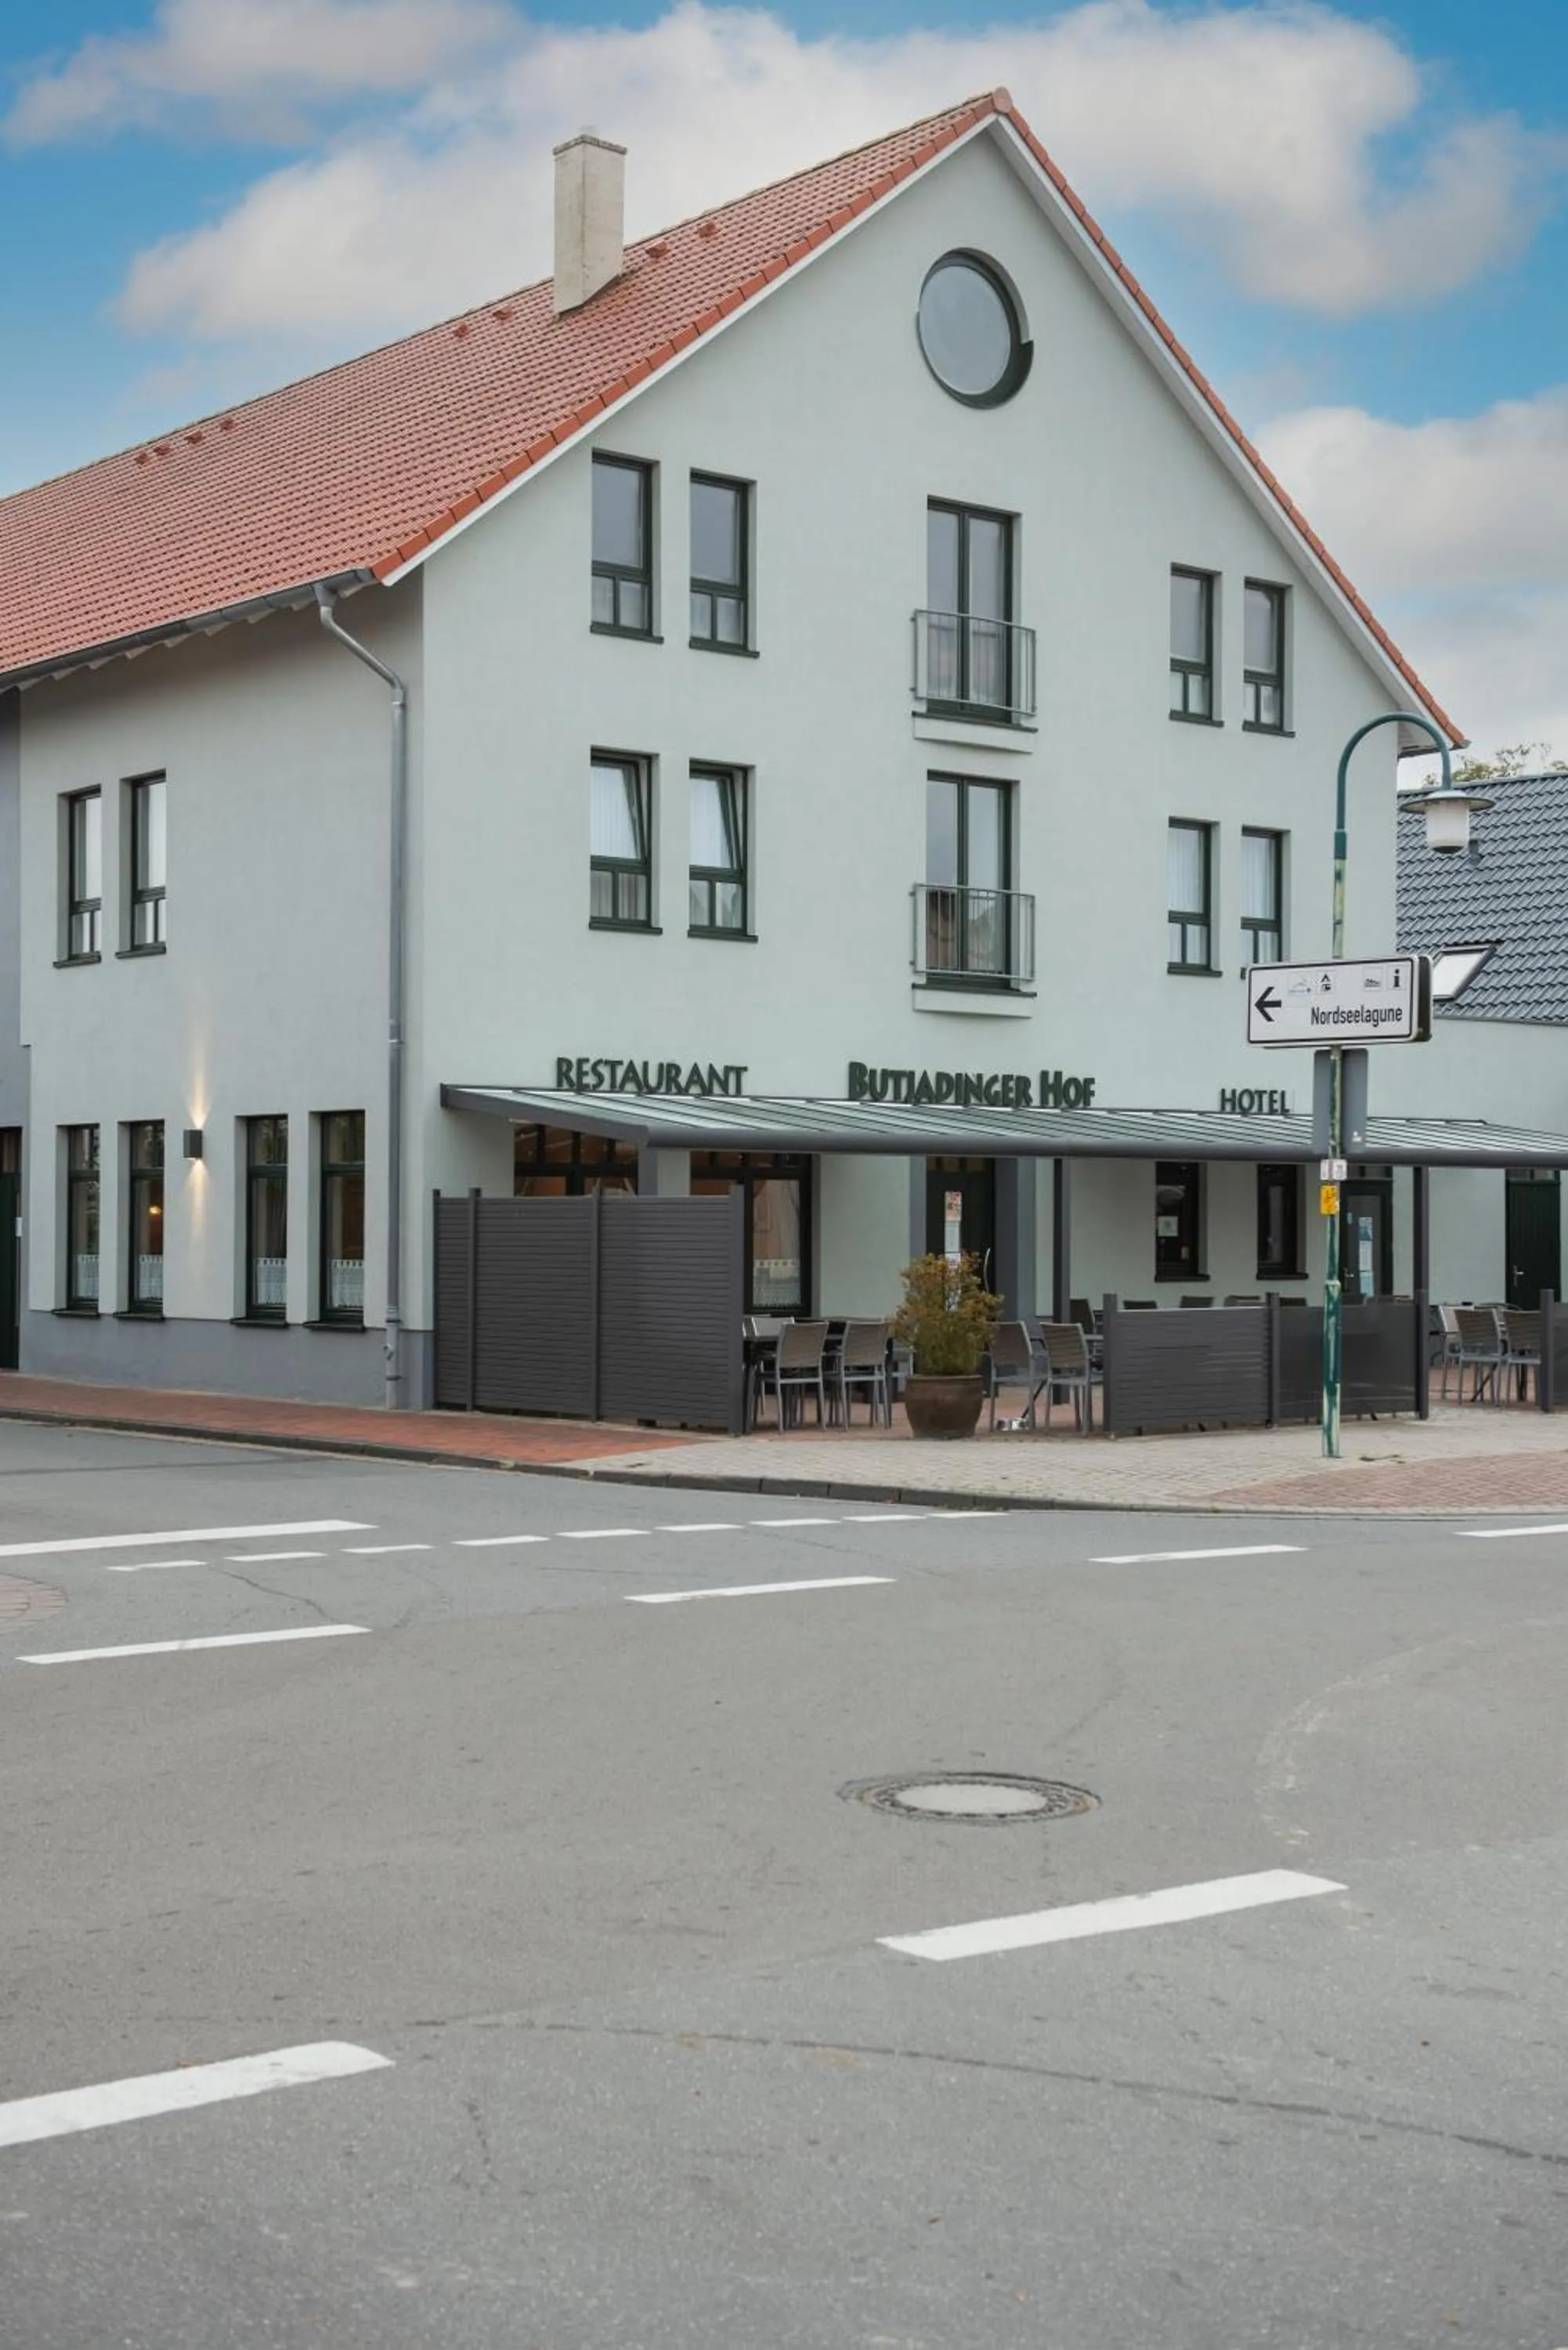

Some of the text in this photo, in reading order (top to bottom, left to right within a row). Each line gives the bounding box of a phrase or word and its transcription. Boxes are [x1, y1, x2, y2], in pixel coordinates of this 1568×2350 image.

[1310, 1005, 1403, 1028] Nordseelagune
[556, 1057, 748, 1095] RESTAURANT
[1039, 1069, 1096, 1108] HOF
[1220, 1088, 1291, 1115] HOTEL
